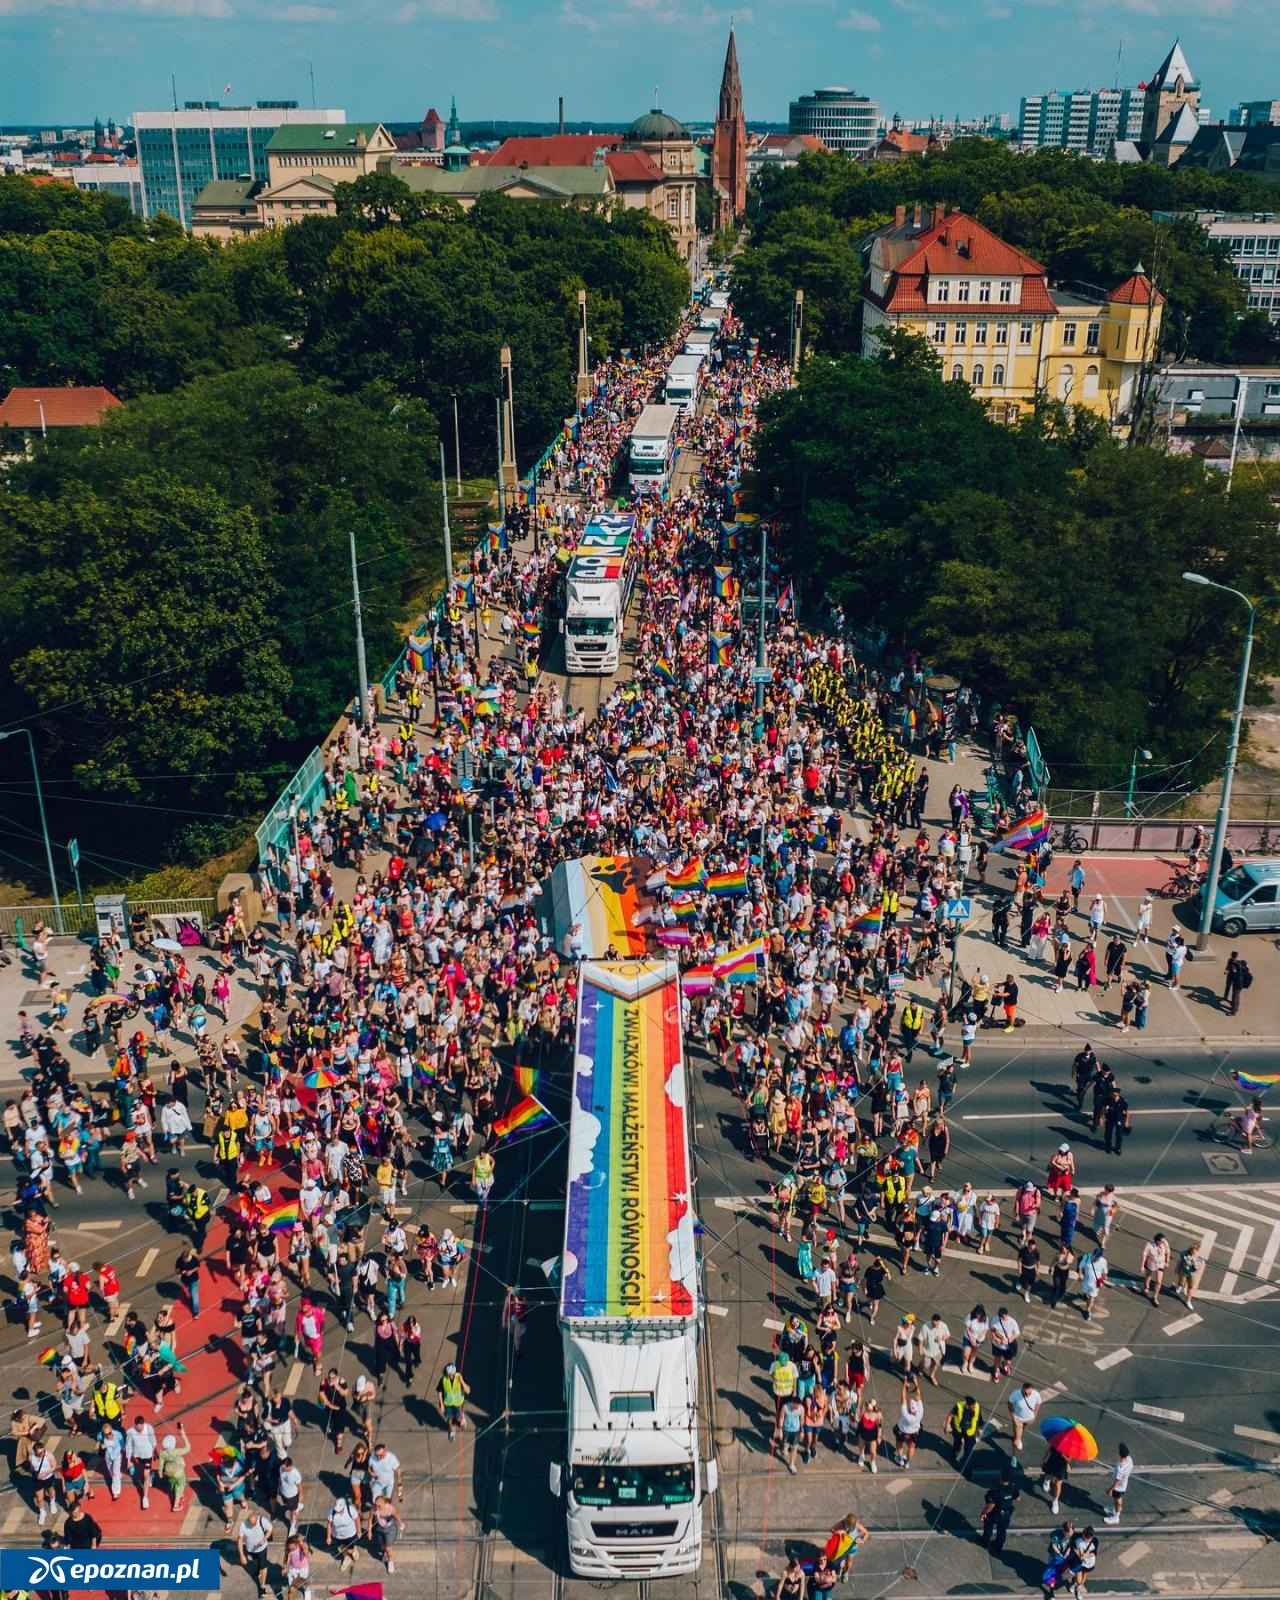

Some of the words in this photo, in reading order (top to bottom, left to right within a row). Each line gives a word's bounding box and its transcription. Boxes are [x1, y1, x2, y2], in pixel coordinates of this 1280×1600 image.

[619, 1009, 643, 1088] ZWIĄZKÓW!
[620, 1092, 644, 1193] MAŁŻEŃSTW!
[620, 1197, 645, 1307] RÓWNOŚCI!
[615, 1528, 654, 1536] MAN
